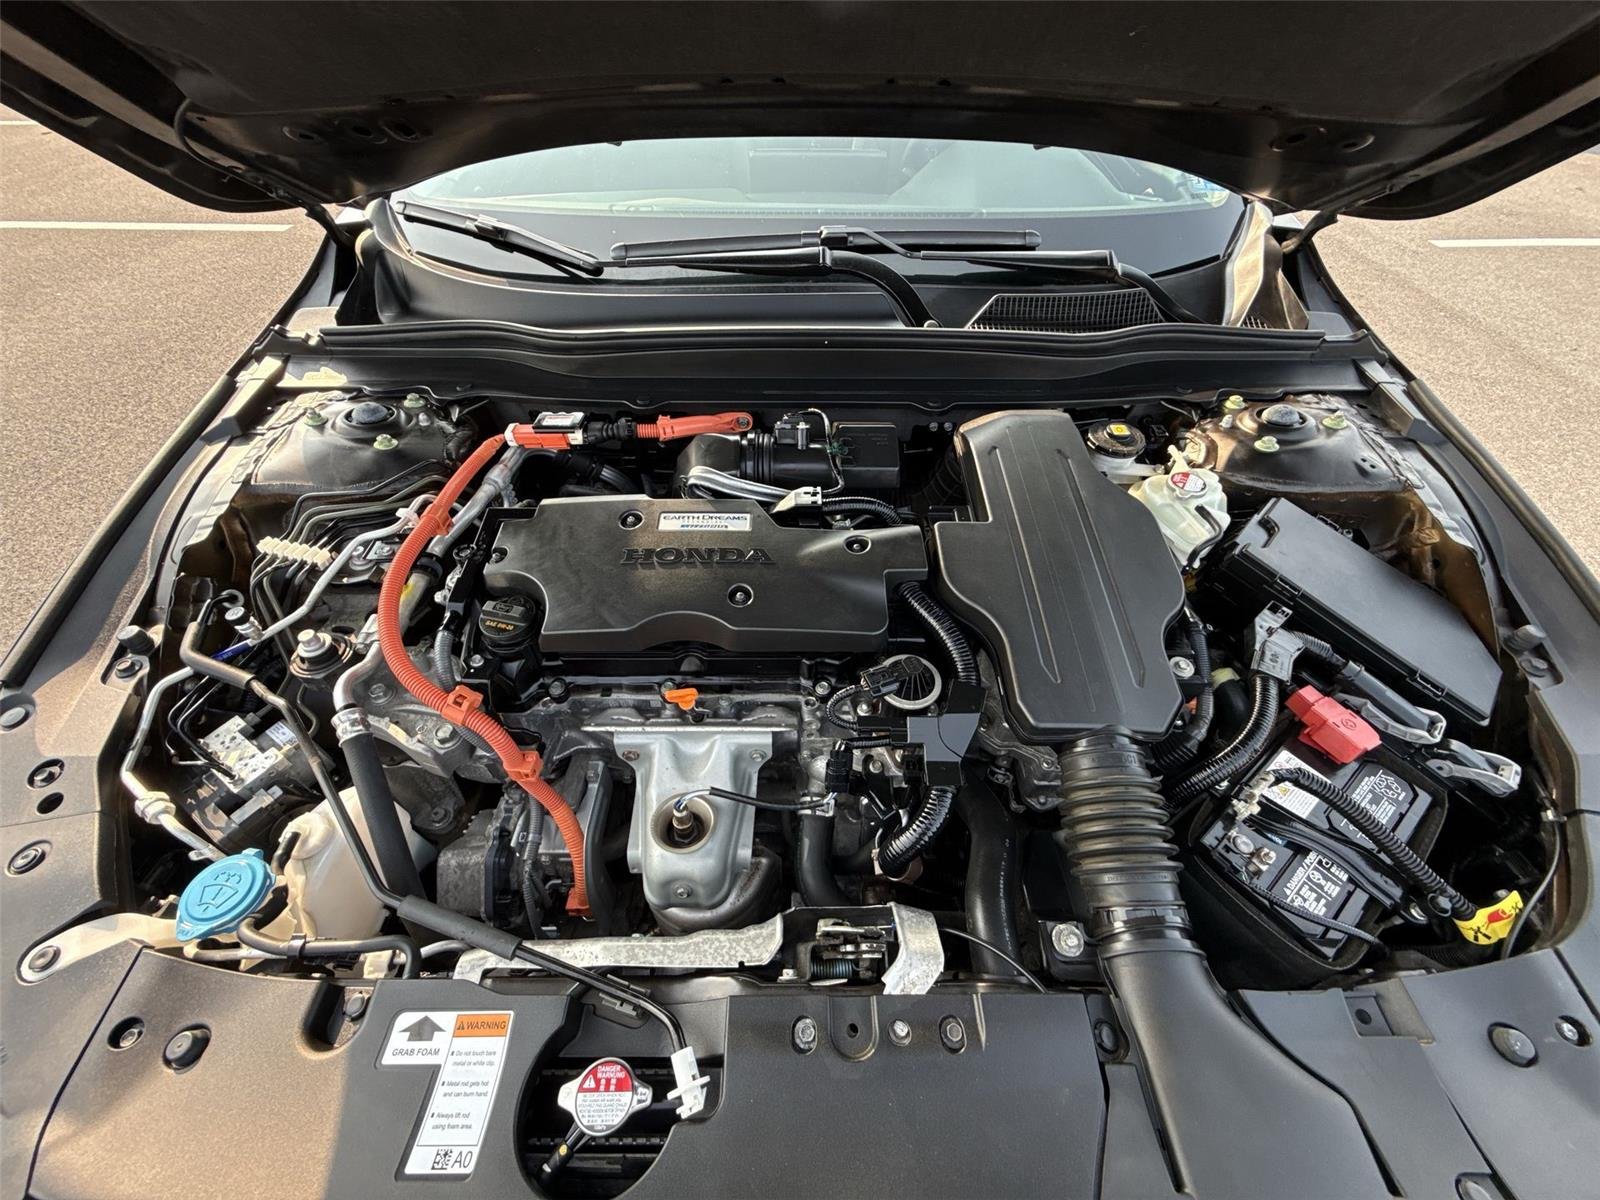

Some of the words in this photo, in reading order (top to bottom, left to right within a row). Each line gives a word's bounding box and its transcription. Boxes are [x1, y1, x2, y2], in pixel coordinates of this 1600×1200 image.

[620, 547, 777, 566] HONDA
[1286, 866, 1306, 890] DANGER
[466, 1020, 507, 1031] WARNING
[391, 1048, 415, 1057] GRAB
[415, 1048, 440, 1057] FOAM
[469, 1081, 480, 1089] gets
[435, 1112, 453, 1120] Always
[450, 1150, 473, 1169] A0
